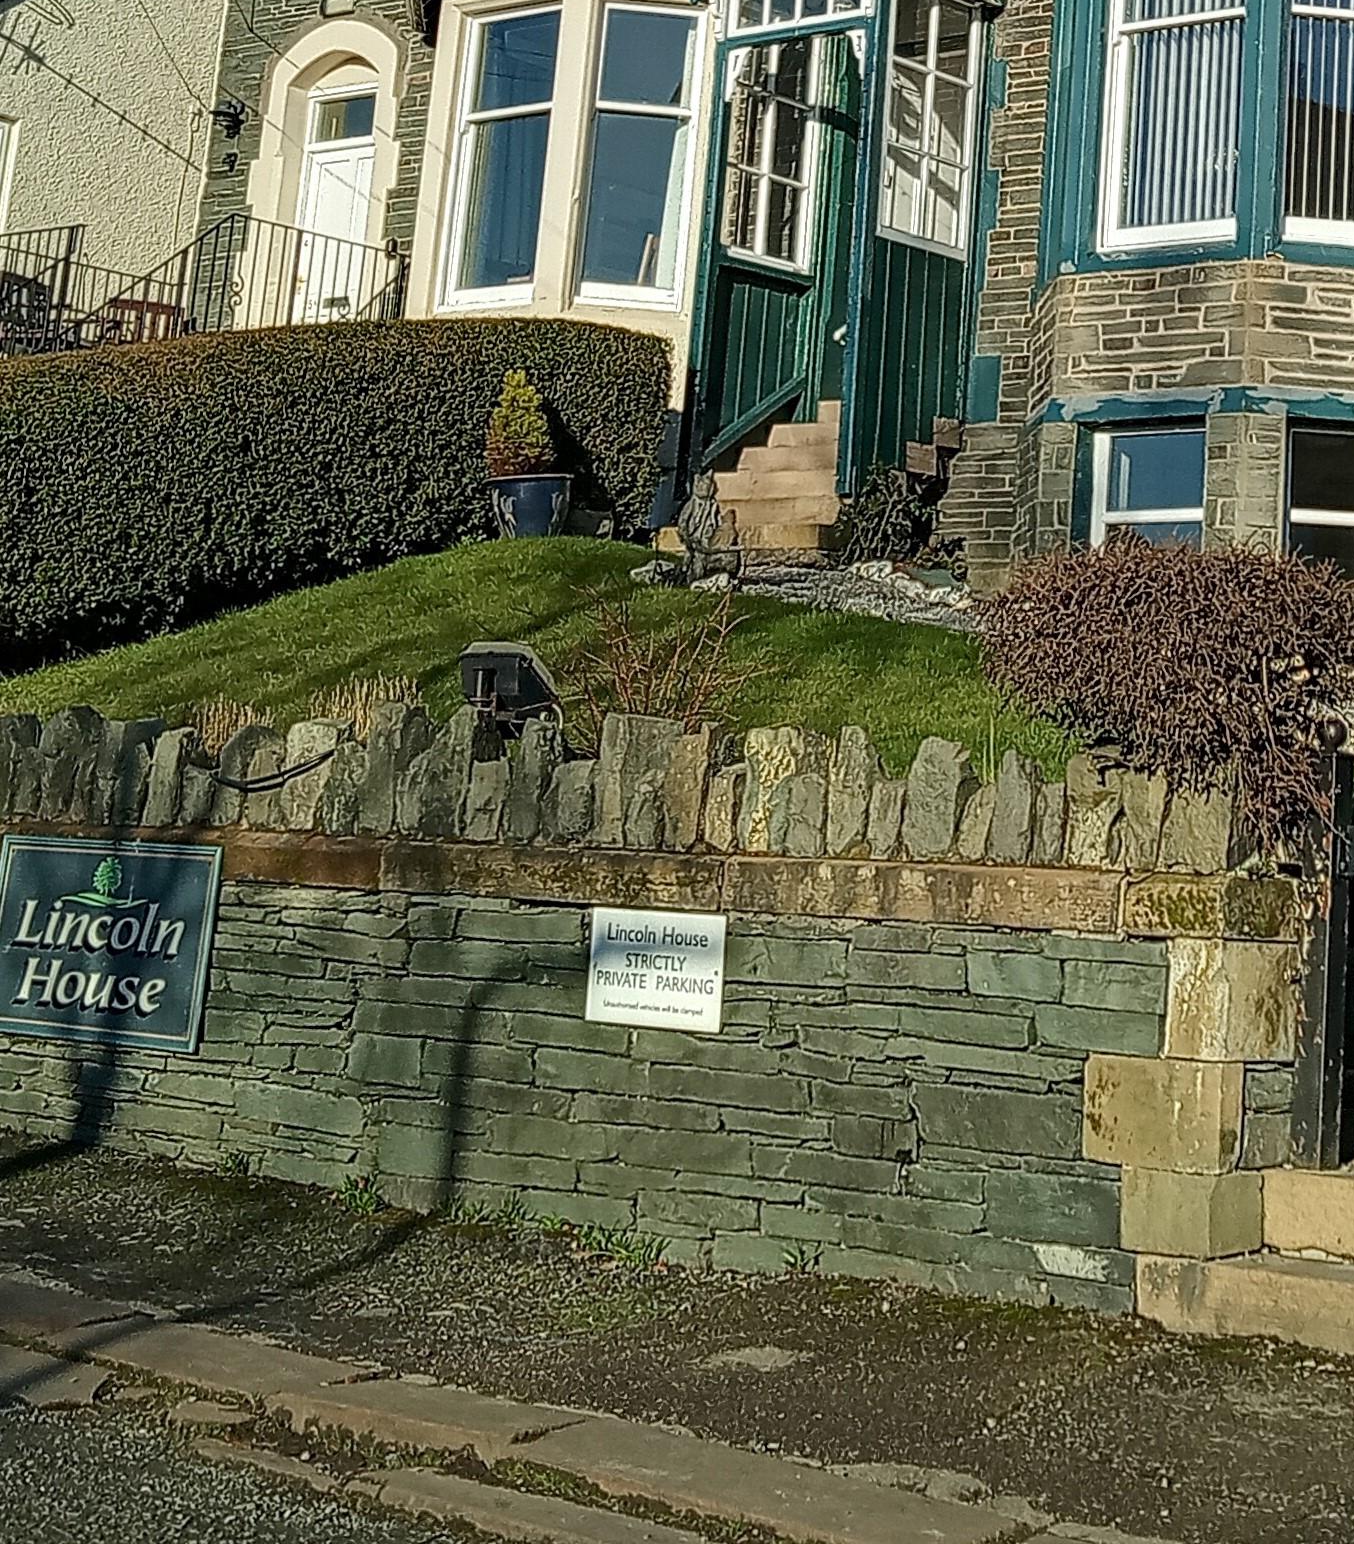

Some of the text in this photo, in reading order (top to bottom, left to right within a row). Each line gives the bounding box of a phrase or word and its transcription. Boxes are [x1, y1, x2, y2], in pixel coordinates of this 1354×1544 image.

[13, 899, 186, 956] Lincoln
[607, 922, 709, 947] Lincoln House
[625, 952, 687, 972] STRICTLY
[16, 957, 167, 1014] House
[596, 970, 714, 995] PRIVATE PARKING
